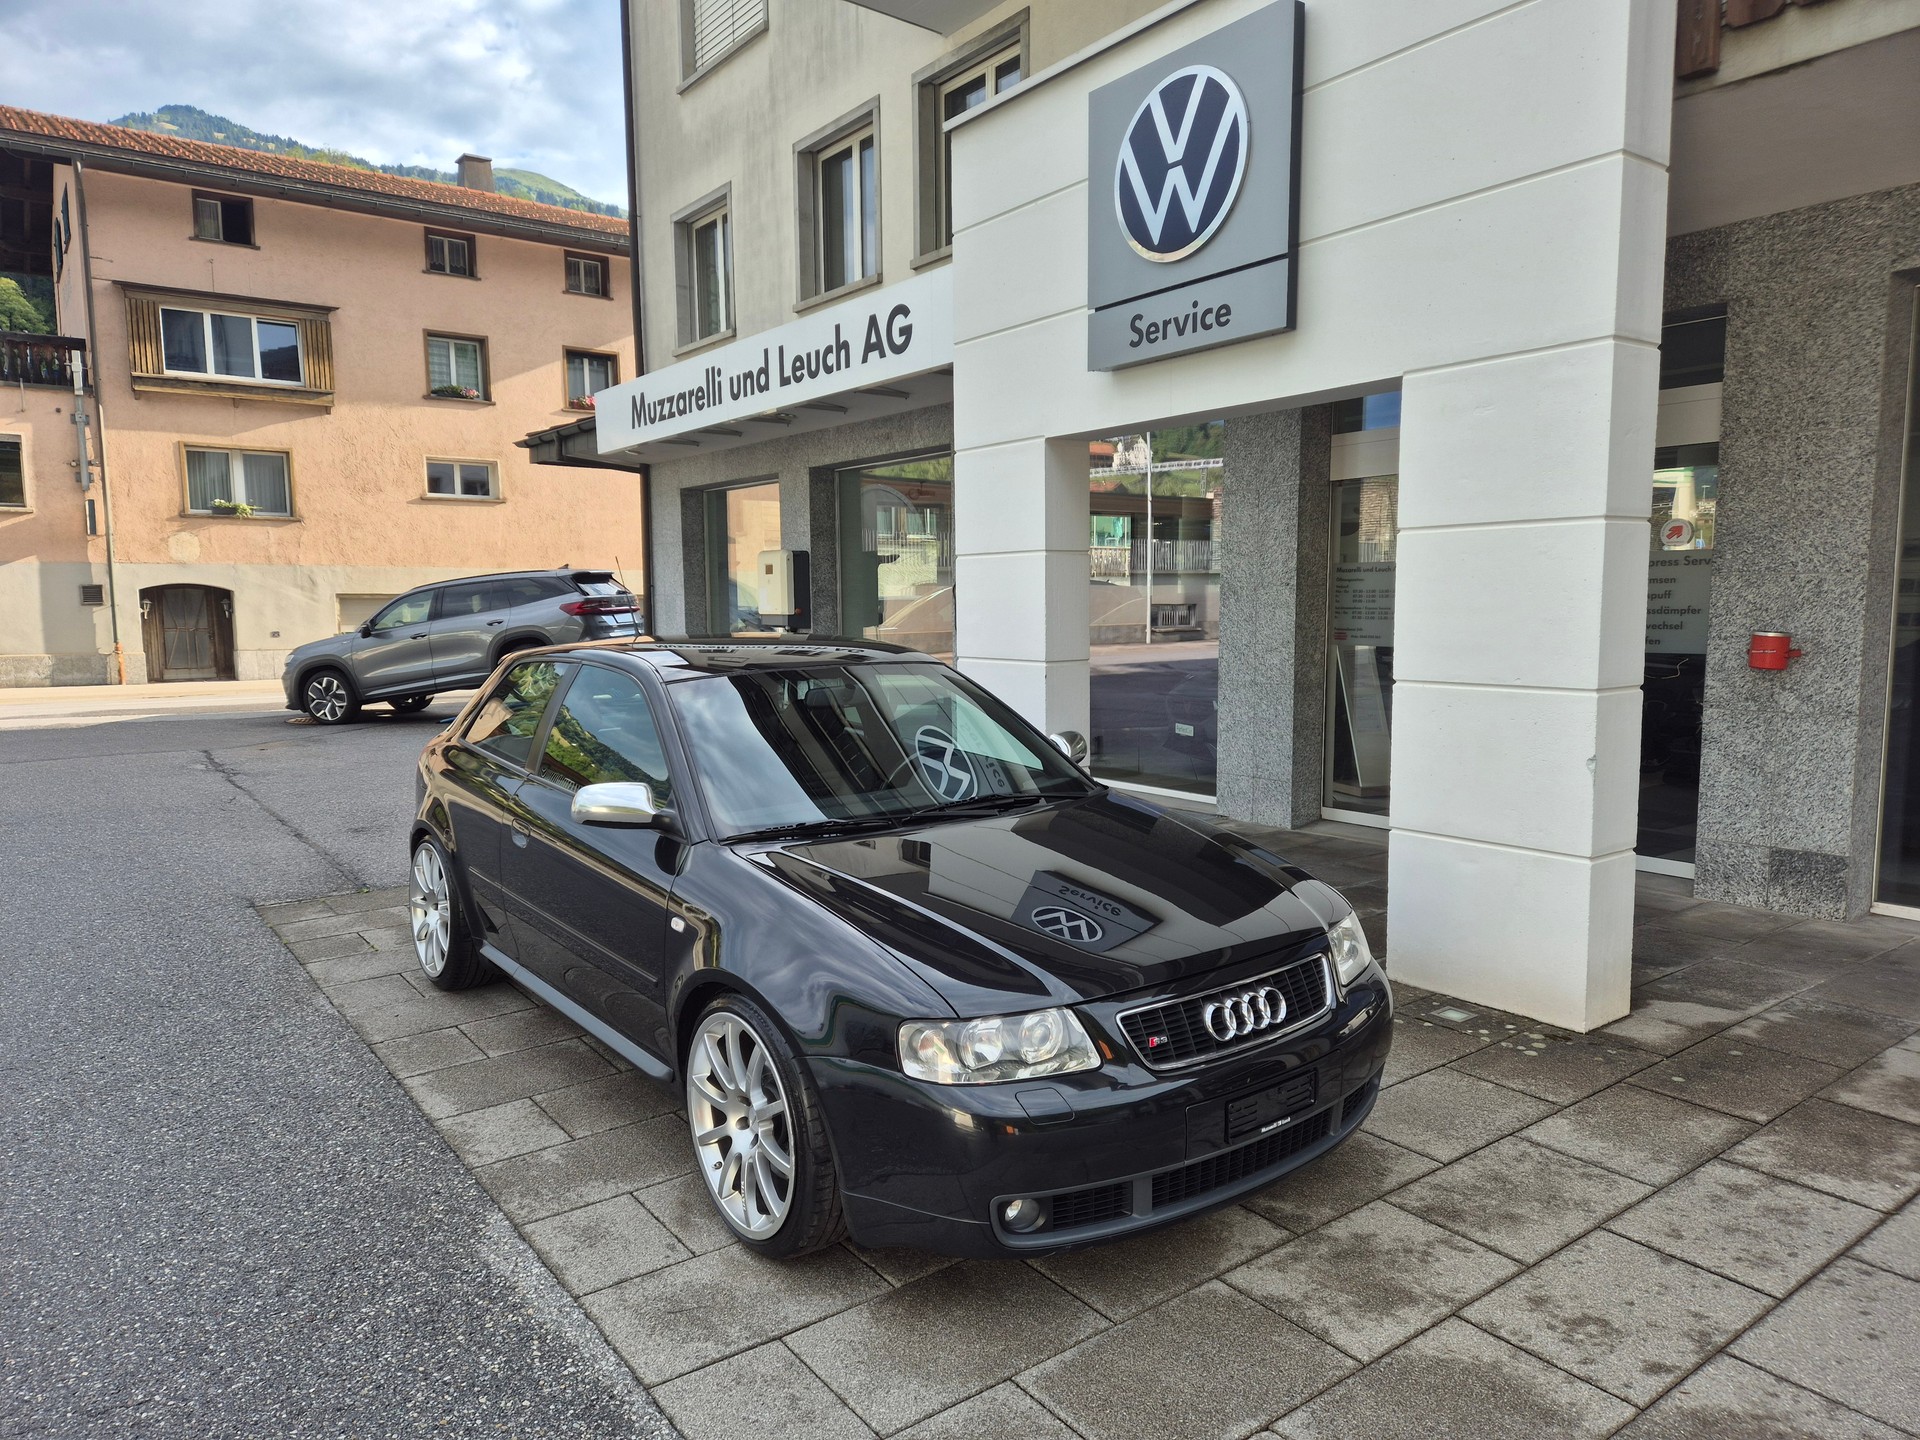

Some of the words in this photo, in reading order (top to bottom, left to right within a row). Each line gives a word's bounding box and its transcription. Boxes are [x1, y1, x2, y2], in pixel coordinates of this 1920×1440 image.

[1129, 300, 1232, 348] Service
[631, 366, 723, 430] Muzzarelli
[729, 347, 770, 401] und
[778, 323, 851, 387] Leuch
[861, 303, 913, 365] AG
[1683, 555, 1711, 566] Serv
